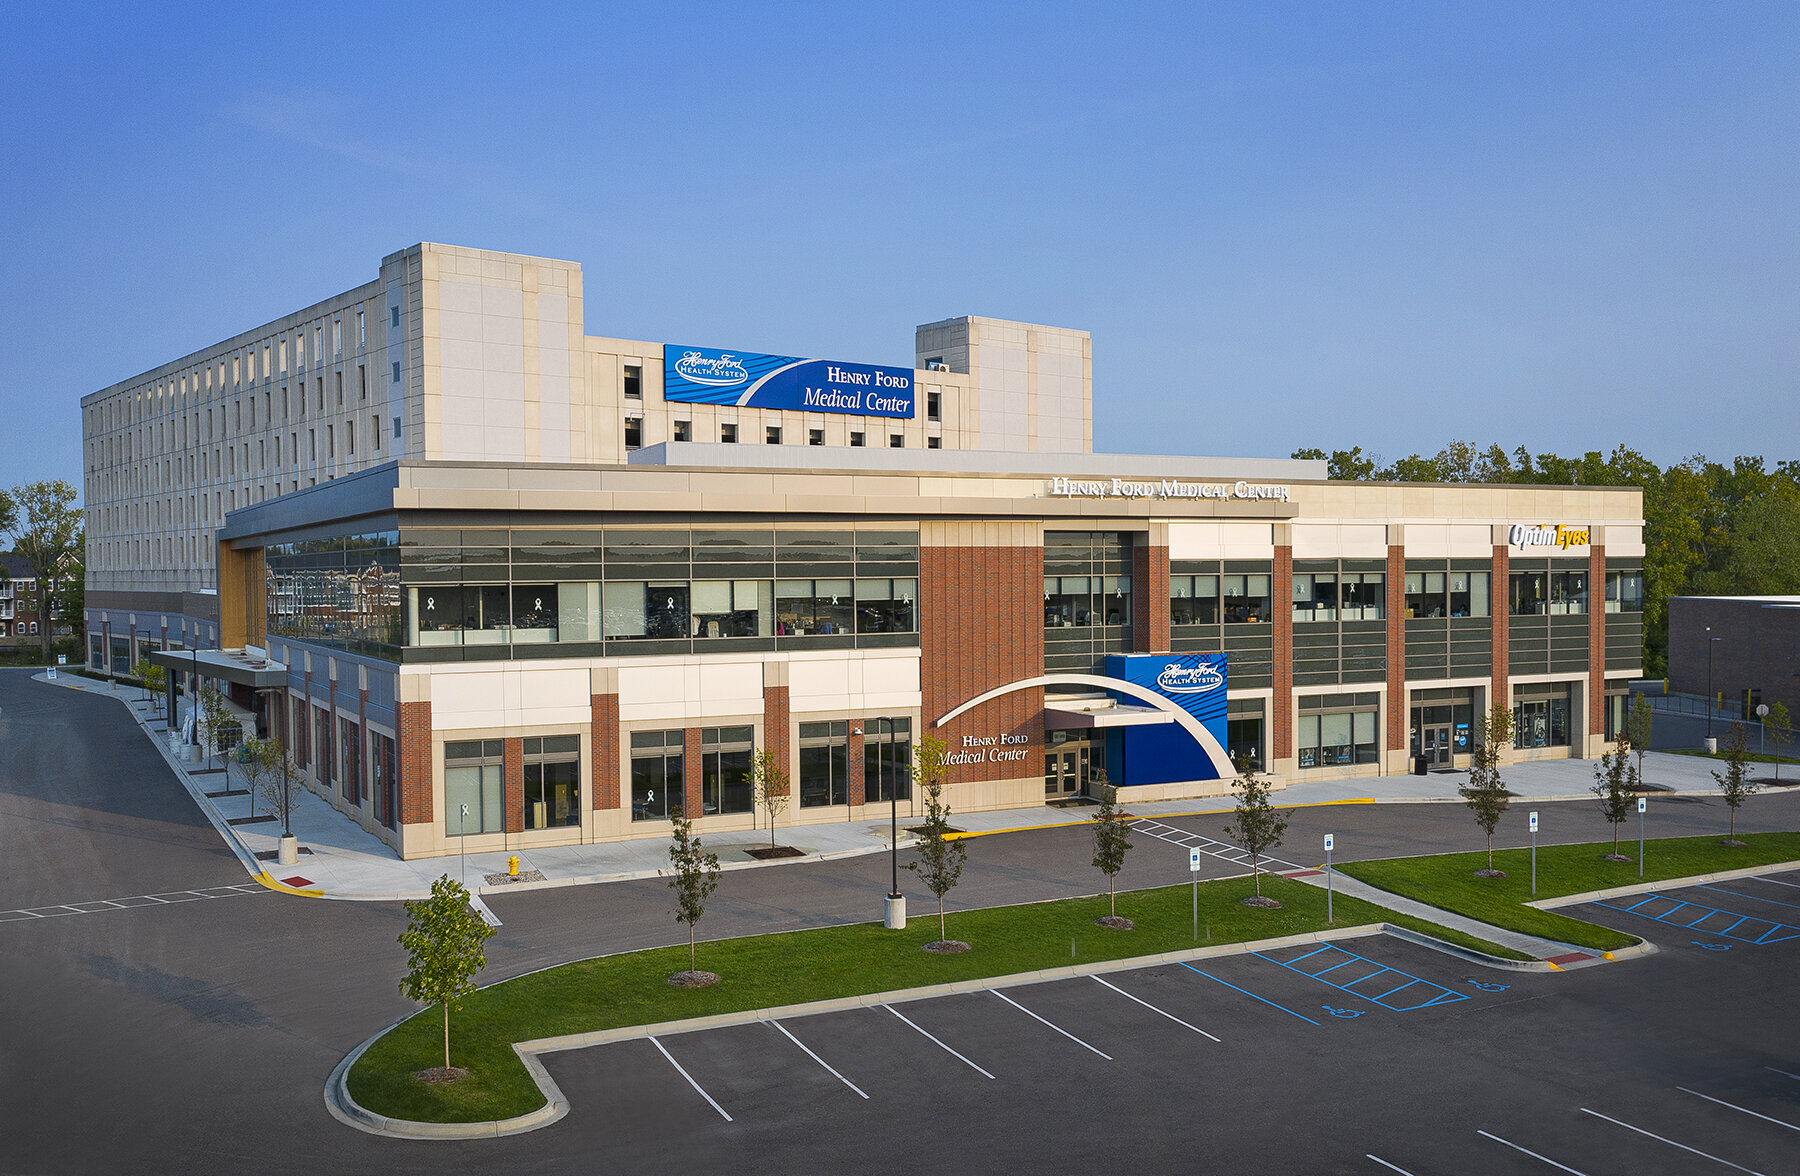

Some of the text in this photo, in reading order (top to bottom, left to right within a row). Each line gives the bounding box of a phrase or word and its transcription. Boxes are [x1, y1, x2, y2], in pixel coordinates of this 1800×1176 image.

[683, 351, 743, 371] Henry Ford
[681, 366, 745, 378] HEALTH SYSTEM
[827, 366, 909, 389] HENRY FORD
[803, 387, 910, 412] Medical Center
[1051, 477, 1290, 498] HENRY FORD MEDICAL CENTER
[1510, 523, 1590, 550] OptimEyes
[962, 733, 1028, 747] HENRY FORD
[989, 748, 1028, 762] Center
